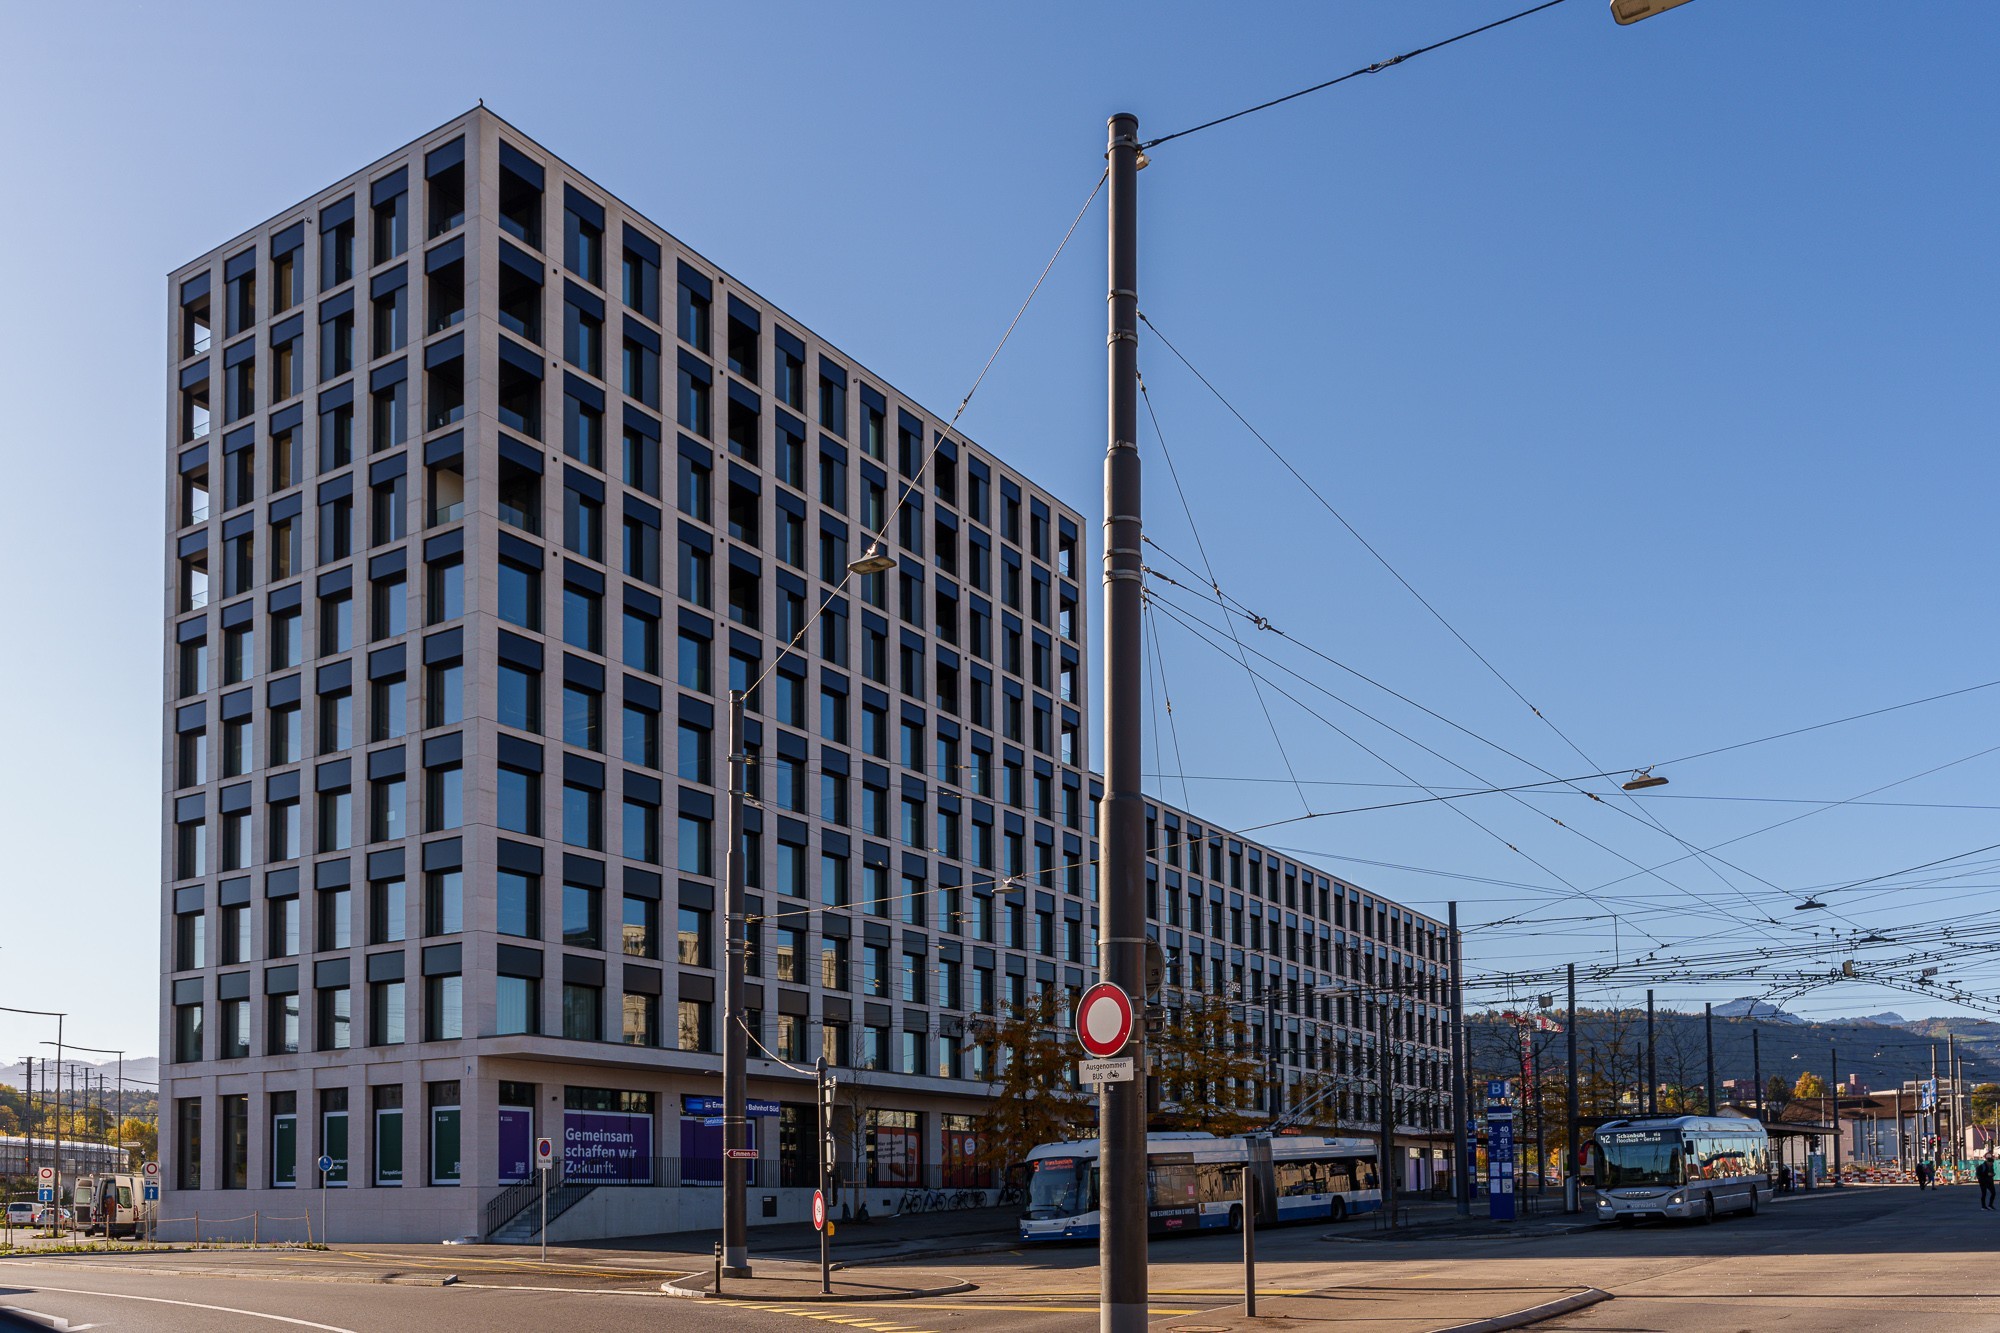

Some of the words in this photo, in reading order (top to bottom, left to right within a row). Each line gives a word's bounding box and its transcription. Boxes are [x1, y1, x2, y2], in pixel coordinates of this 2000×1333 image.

[1086, 1062, 1127, 1071] Ausgenommen
[1491, 1082, 1501, 1094] B
[748, 1103, 769, 1112] Bahnhof
[565, 1128, 633, 1143] Gemeinsam
[1600, 1135, 1611, 1144] 42
[565, 1144, 616, 1158] schaffen
[618, 1146, 637, 1159] wir
[565, 1160, 617, 1175] Zukunft.
[1033, 1161, 1040, 1172] 5
